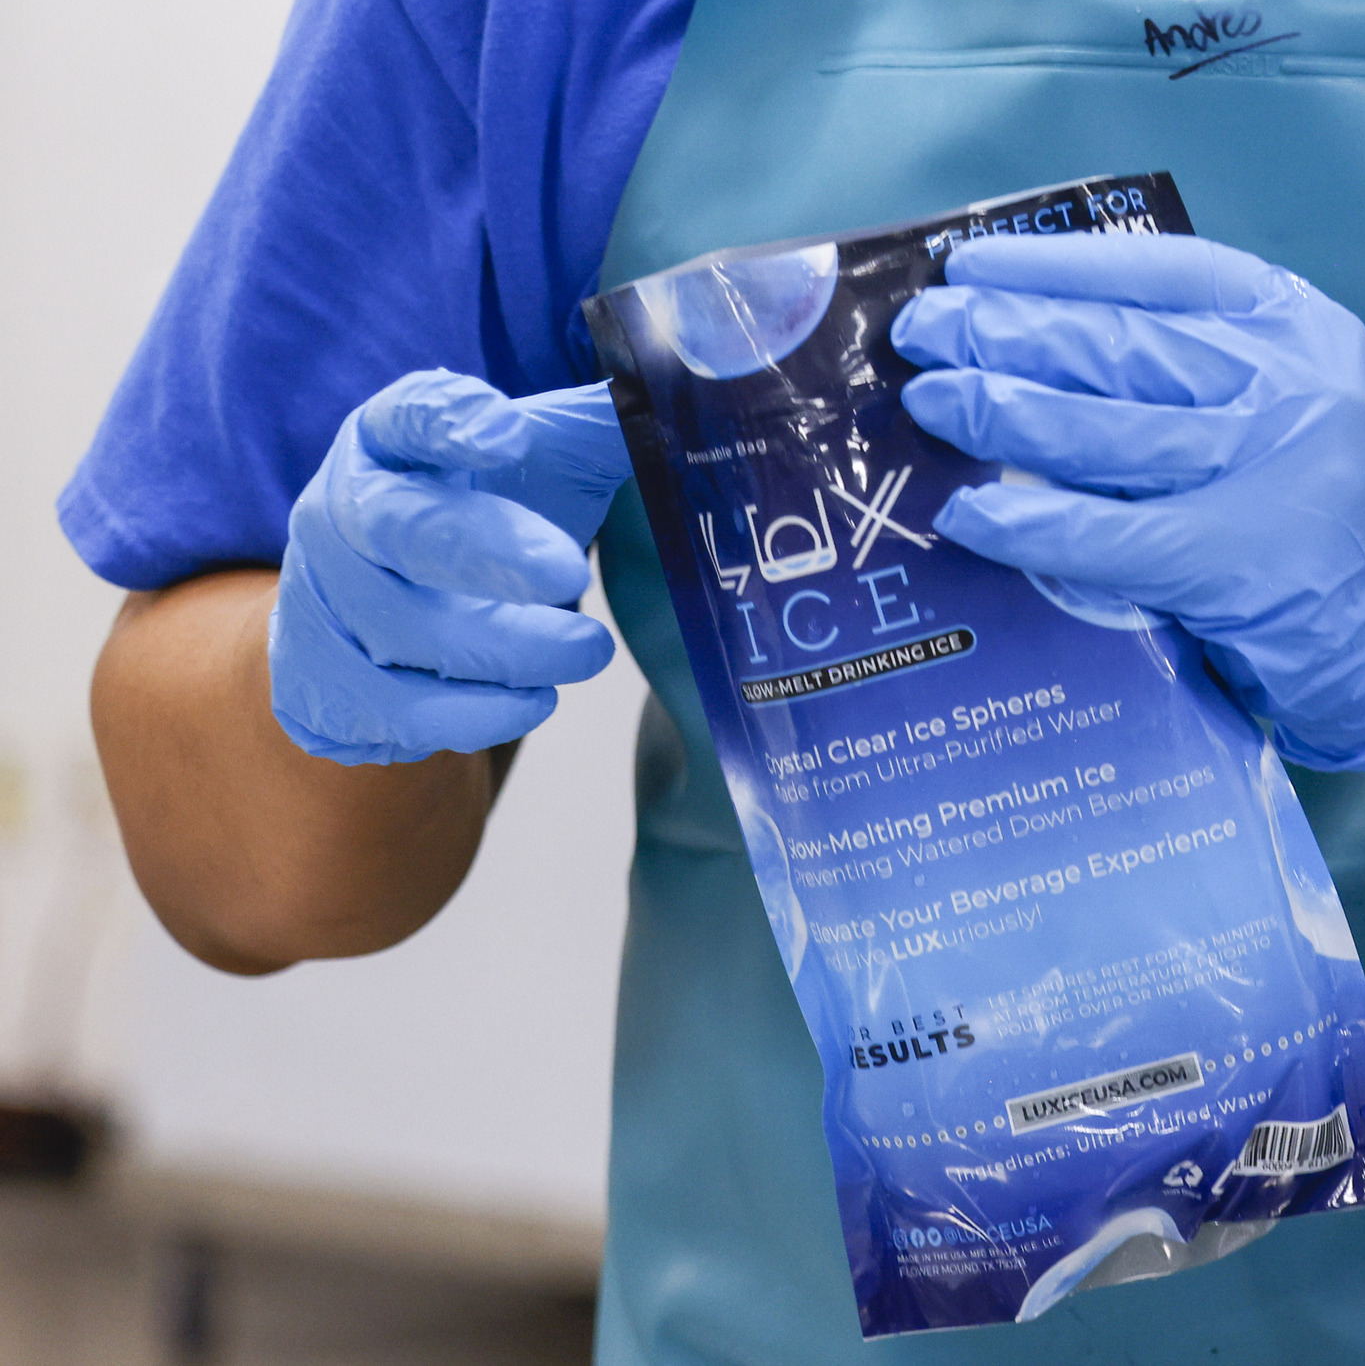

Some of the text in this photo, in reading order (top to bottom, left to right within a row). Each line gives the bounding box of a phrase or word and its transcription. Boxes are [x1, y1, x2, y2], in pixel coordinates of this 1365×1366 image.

[1087, 187, 1147, 221] FOR
[736, 438, 767, 457] Bag
[742, 632, 963, 701] SLOW-MELT DRINKING ICE
[765, 684, 1066, 781] Crystal Clear Ice Spheres
[812, 769, 871, 799] from
[876, 717, 1044, 783] Ultra-Purified
[1048, 699, 1122, 735] Water
[788, 762, 1116, 861] Slow-Melting Premium Ice
[794, 764, 1215, 888] Preventing Watered Down Beverages
[809, 818, 1237, 945] Elevate Your Beverage Experience
[890, 904, 1043, 961] LUXuriously!
[1252, 935, 1271, 952] TO
[1100, 957, 1141, 979] REST
[891, 1003, 964, 1036] BEST
[1079, 996, 1123, 1019] OVER
[1128, 989, 1152, 1006] OR
[1022, 1065, 1187, 1123] LUXICEUSA.COM
[1217, 1087, 1273, 1116] Water
[898, 1264, 940, 1278] FLOWER
[950, 1250, 967, 1260] USA
